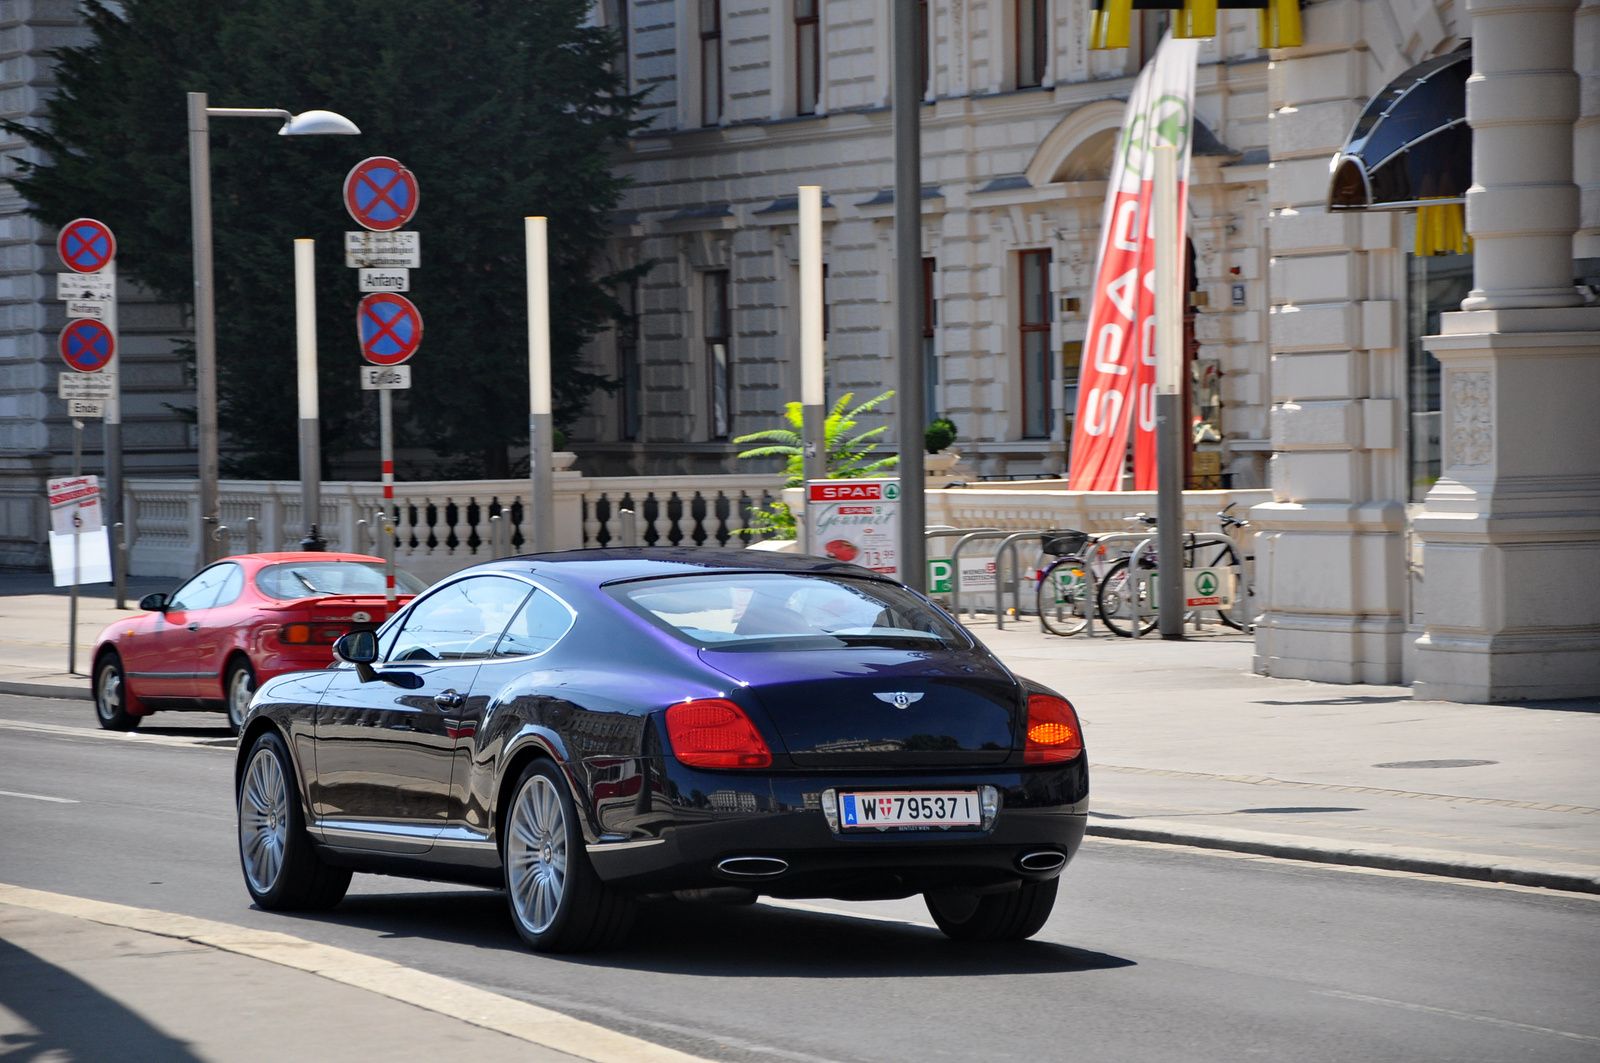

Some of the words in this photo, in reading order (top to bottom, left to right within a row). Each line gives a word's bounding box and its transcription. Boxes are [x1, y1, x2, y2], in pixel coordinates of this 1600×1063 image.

[75, 402, 98, 413] Ende
[823, 487, 880, 498] SPAR
[929, 561, 953, 591] P
[862, 798, 877, 820] W
[847, 813, 855, 821] A
